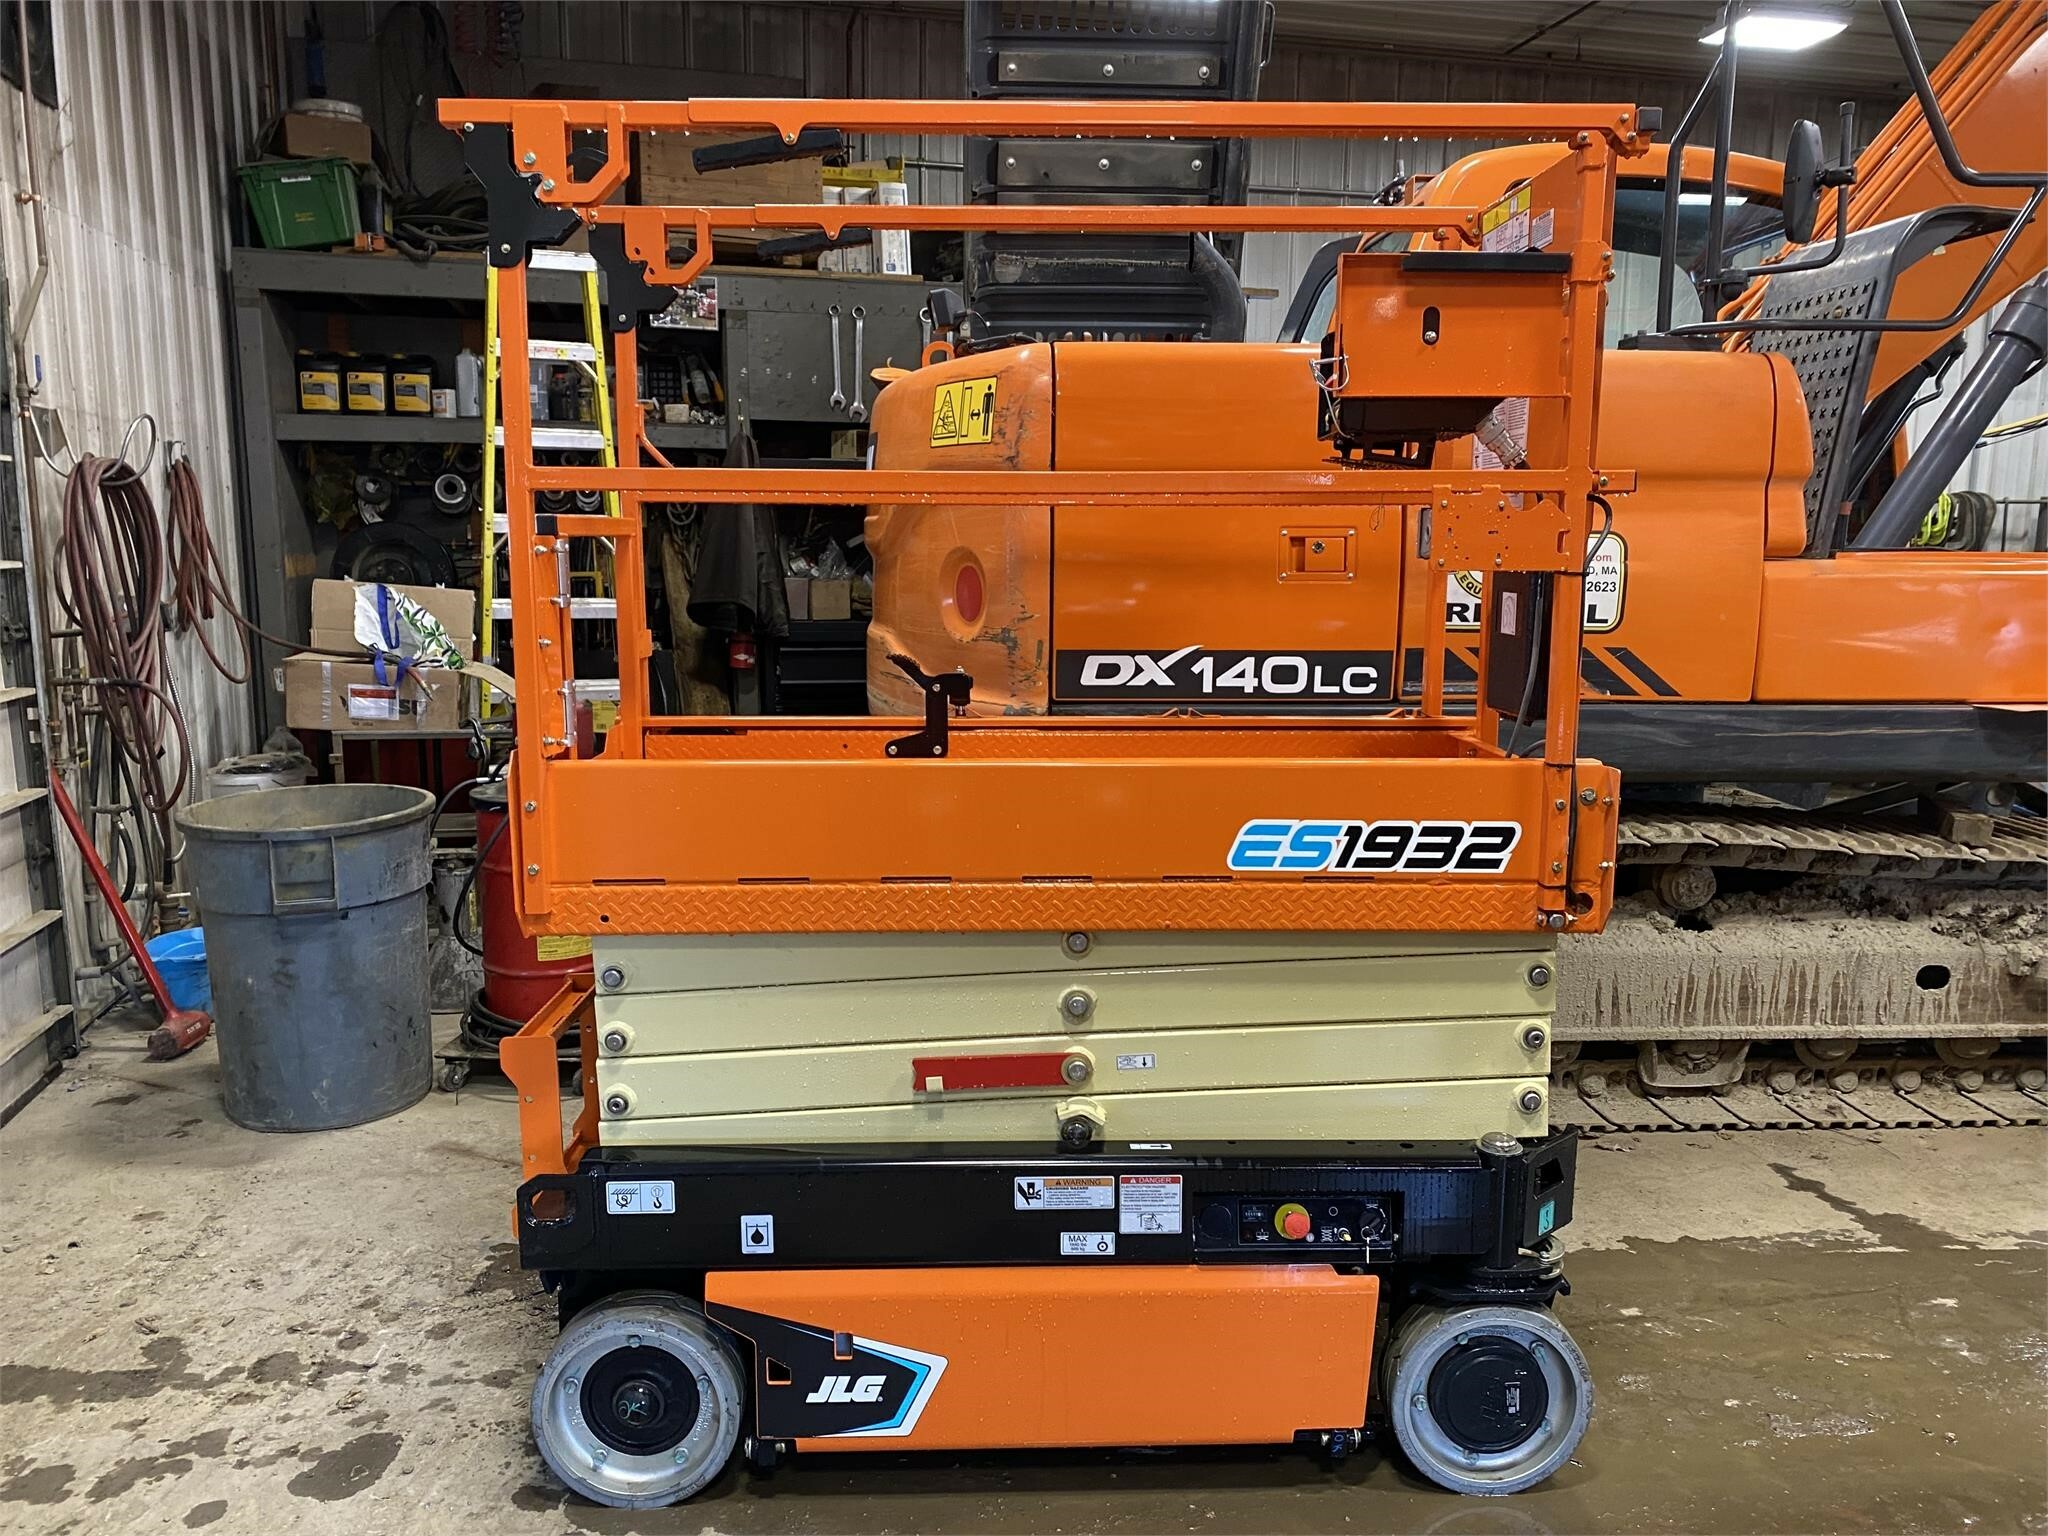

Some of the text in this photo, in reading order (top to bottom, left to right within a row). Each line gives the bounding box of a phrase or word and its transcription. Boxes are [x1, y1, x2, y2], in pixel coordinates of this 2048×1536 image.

[1601, 566, 1618, 575] MA
[1586, 581, 1617, 593] 2623
[1080, 645, 1204, 686] DX
[1229, 822, 1519, 871] ES1932
[1063, 1178, 1102, 1186] WARNING
[1068, 1235, 1088, 1243] MAX
[805, 1375, 887, 1403] JLG
